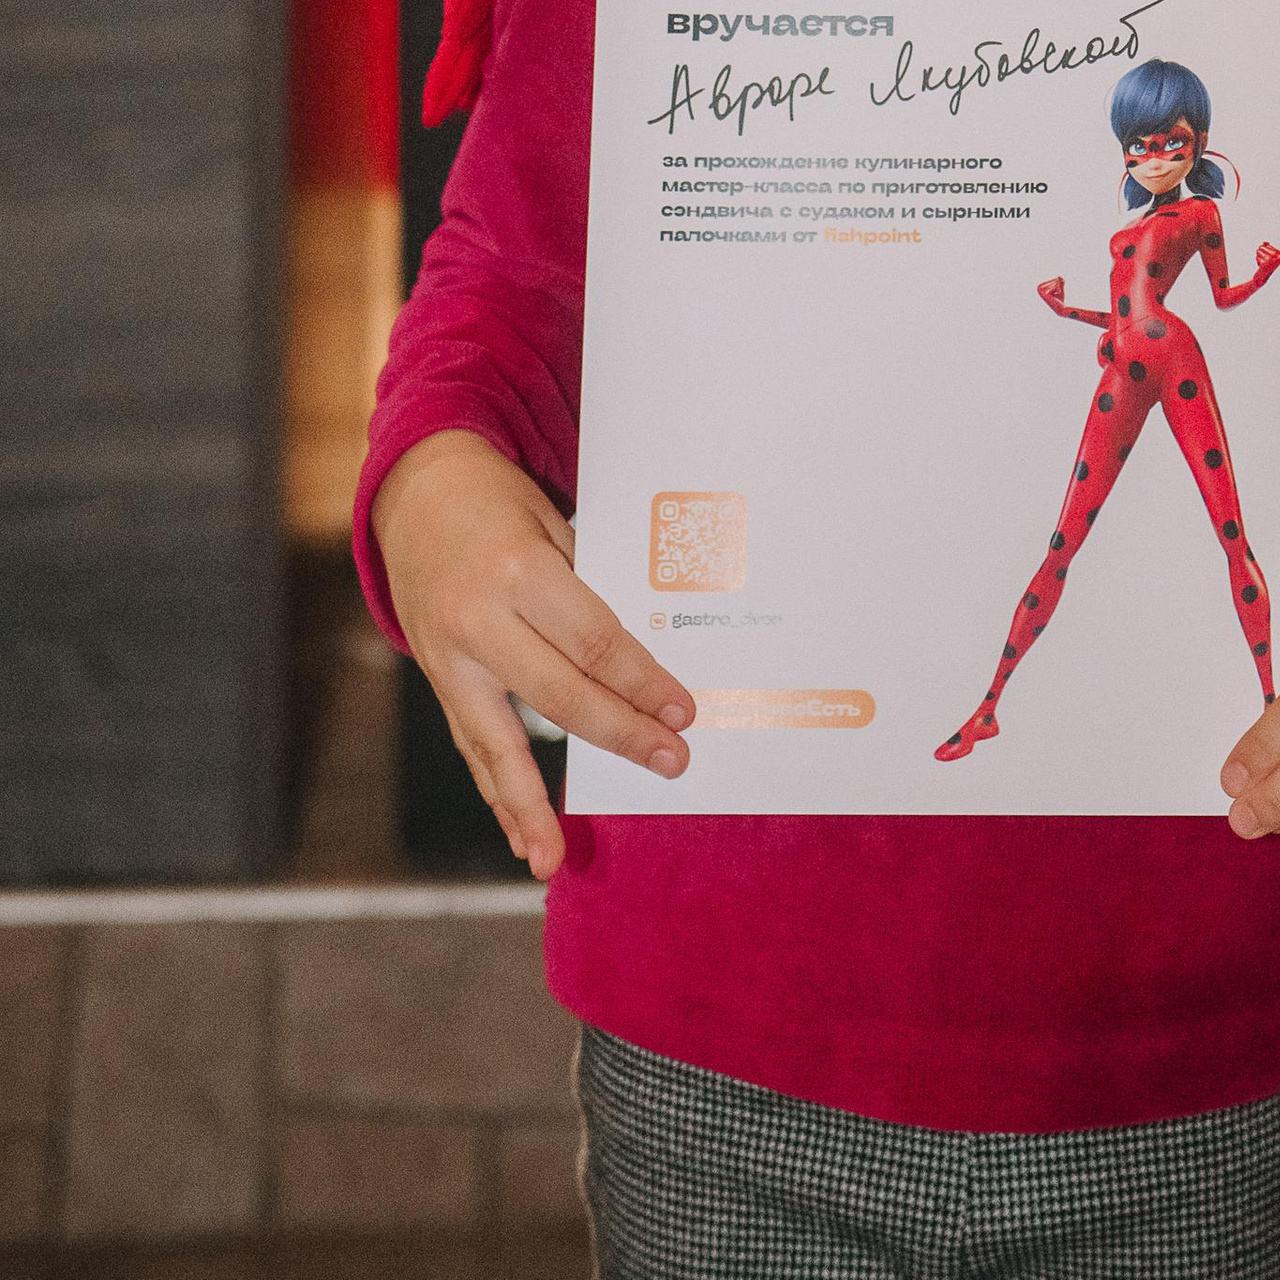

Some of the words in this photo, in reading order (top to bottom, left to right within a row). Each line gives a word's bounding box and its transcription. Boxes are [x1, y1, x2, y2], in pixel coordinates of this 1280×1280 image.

[667, 13, 894, 41] вручается
[648, 64, 835, 135] Авроре
[662, 156, 688, 168] за
[694, 156, 849, 172] прохождение
[855, 157, 1002, 173] кулинарного
[662, 181, 832, 196] мастер-класса
[838, 182, 866, 194] по
[871, 182, 1048, 197] приготовлению
[661, 205, 773, 219] сэндвича
[780, 206, 792, 218] с
[798, 206, 895, 221] судаком
[901, 207, 916, 219] и
[922, 206, 1030, 222] сырными
[660, 230, 786, 243] палочками
[793, 231, 818, 243] от
[823, 227, 922, 246] fishpoint
